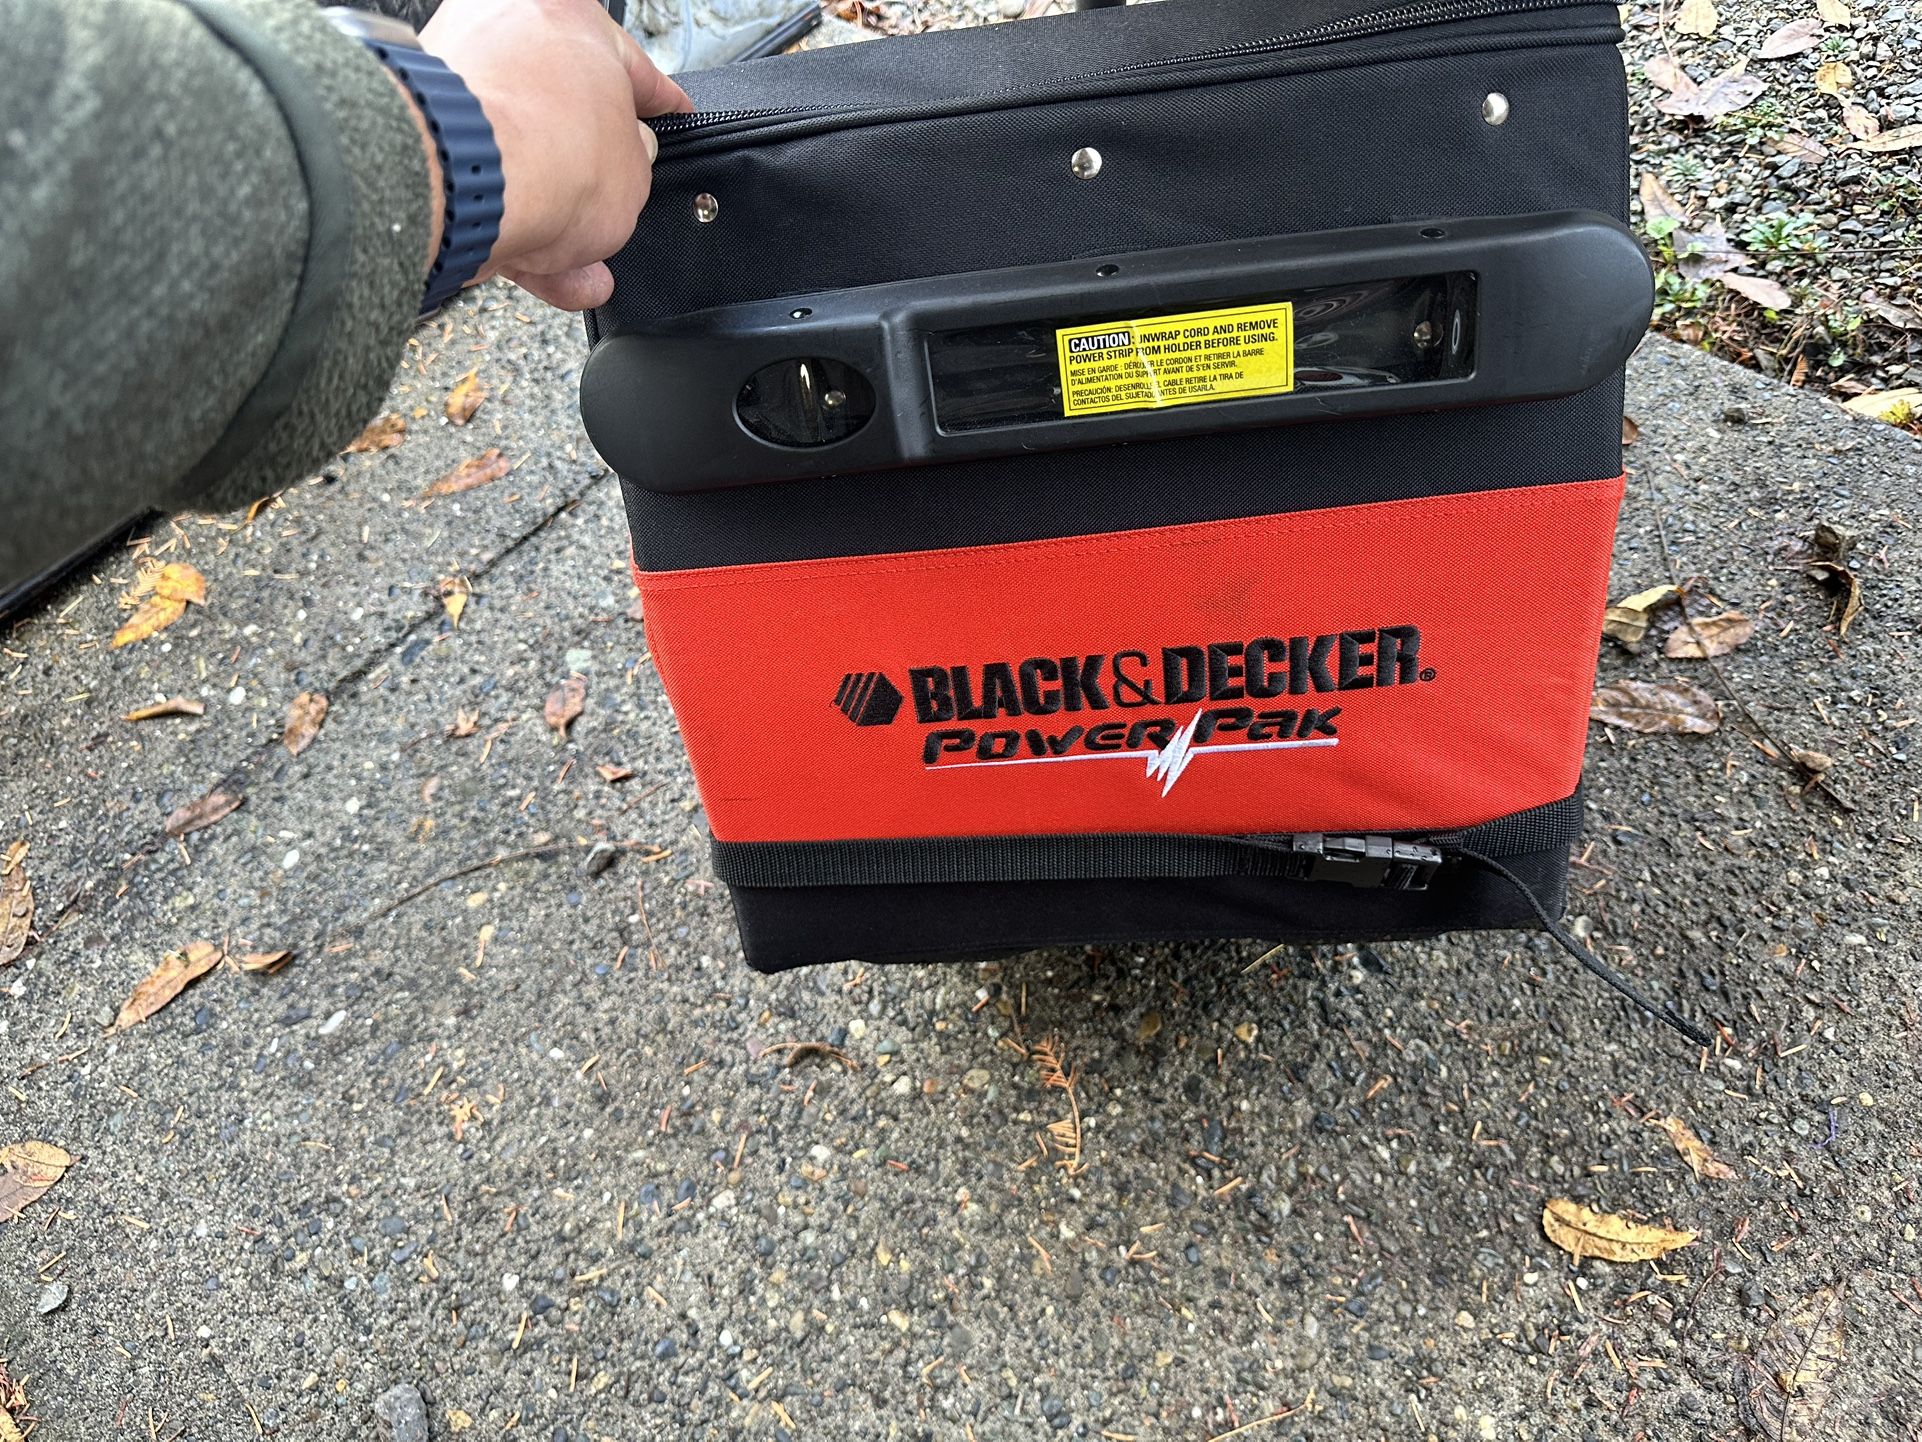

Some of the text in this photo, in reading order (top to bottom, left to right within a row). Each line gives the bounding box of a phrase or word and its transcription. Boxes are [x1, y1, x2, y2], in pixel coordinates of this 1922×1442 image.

[1183, 326, 1210, 339] CORD
[1212, 323, 1234, 336] AND
[1236, 318, 1279, 333] REMOVE
[1069, 351, 1104, 365] POWER
[1106, 347, 1134, 360] STRIP
[1163, 340, 1202, 354] HOLDER
[1204, 335, 1241, 349] BEFORE
[1243, 331, 1278, 345] USING.
[1070, 368, 1086, 378] MISE
[1087, 367, 1096, 375] EN
[1097, 364, 1119, 374] GARDE
[1156, 359, 1164, 367] LE
[1165, 356, 1193, 366] CORDON
[1194, 354, 1203, 363] ET
[1204, 351, 1231, 361] RETIRER
[1232, 350, 1241, 359] LA
[1242, 347, 1265, 358] BARRE
[1071, 373, 1123, 386] D'ALIMENTATION
[1124, 371, 1134, 379] DU
[1163, 365, 1184, 375] AVANT
[1185, 364, 1194, 373] DE
[1195, 362, 1211, 372] S'EN
[1212, 360, 1238, 370] SERVIR.
[1072, 386, 1114, 398] PRECAUCIÓN:
[1163, 378, 1184, 387] CABLE
[1185, 375, 1208, 385] RETIRE
[1208, 374, 1218, 383] LA
[1219, 372, 1234, 381] TIRA
[1235, 371, 1244, 380] DE
[1073, 395, 1111, 407] CONTACTOS
[1111, 393, 1123, 402] DEL
[1178, 386, 1187, 395] DE
[1188, 383, 1215, 394] USARLA.
